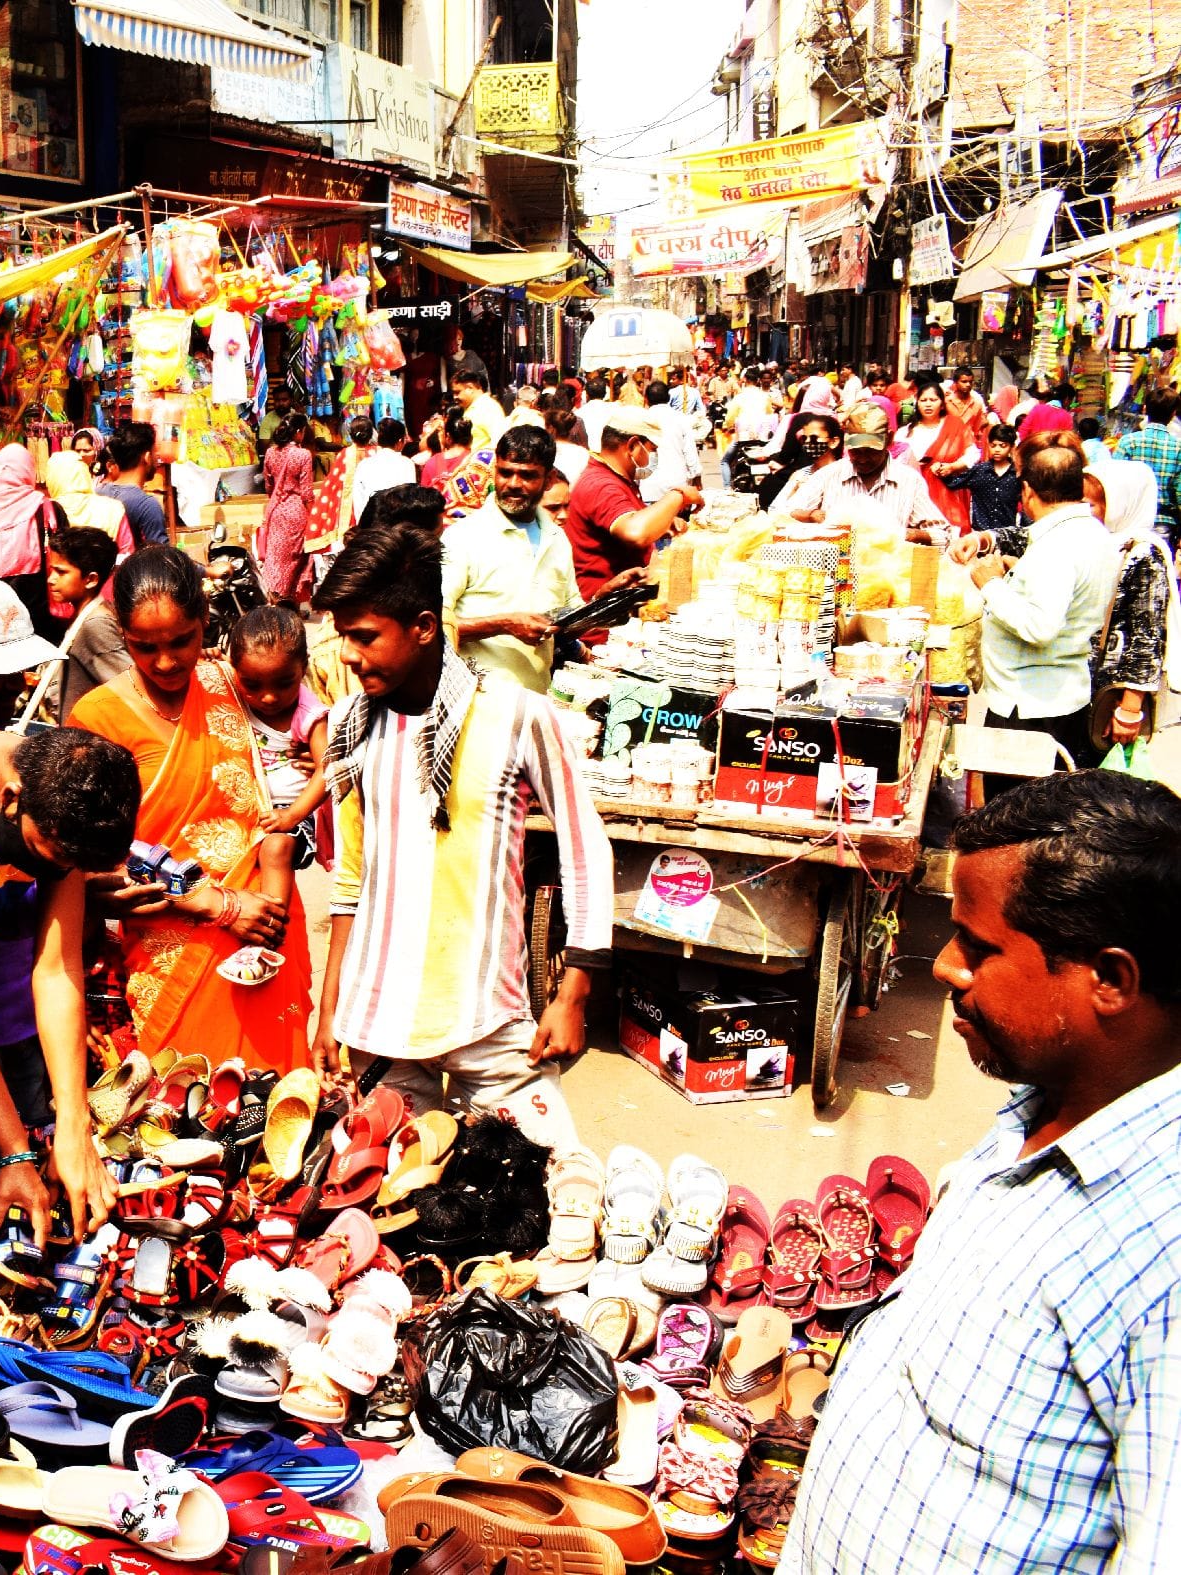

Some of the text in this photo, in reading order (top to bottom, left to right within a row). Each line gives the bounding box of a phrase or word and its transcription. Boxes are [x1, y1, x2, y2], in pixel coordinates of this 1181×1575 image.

[747, 178, 793, 198] जनरल
[391, 192, 417, 224] कृष्णा
[709, 225, 750, 249] दीप
[420, 300, 452, 321] साड़ी
[642, 708, 703, 730] GROW
[753, 736, 821, 758] SANSO
[633, 994, 663, 1022] SANSO
[715, 1029, 767, 1044] SANSO
[705, 1061, 746, 1087] Mugs
